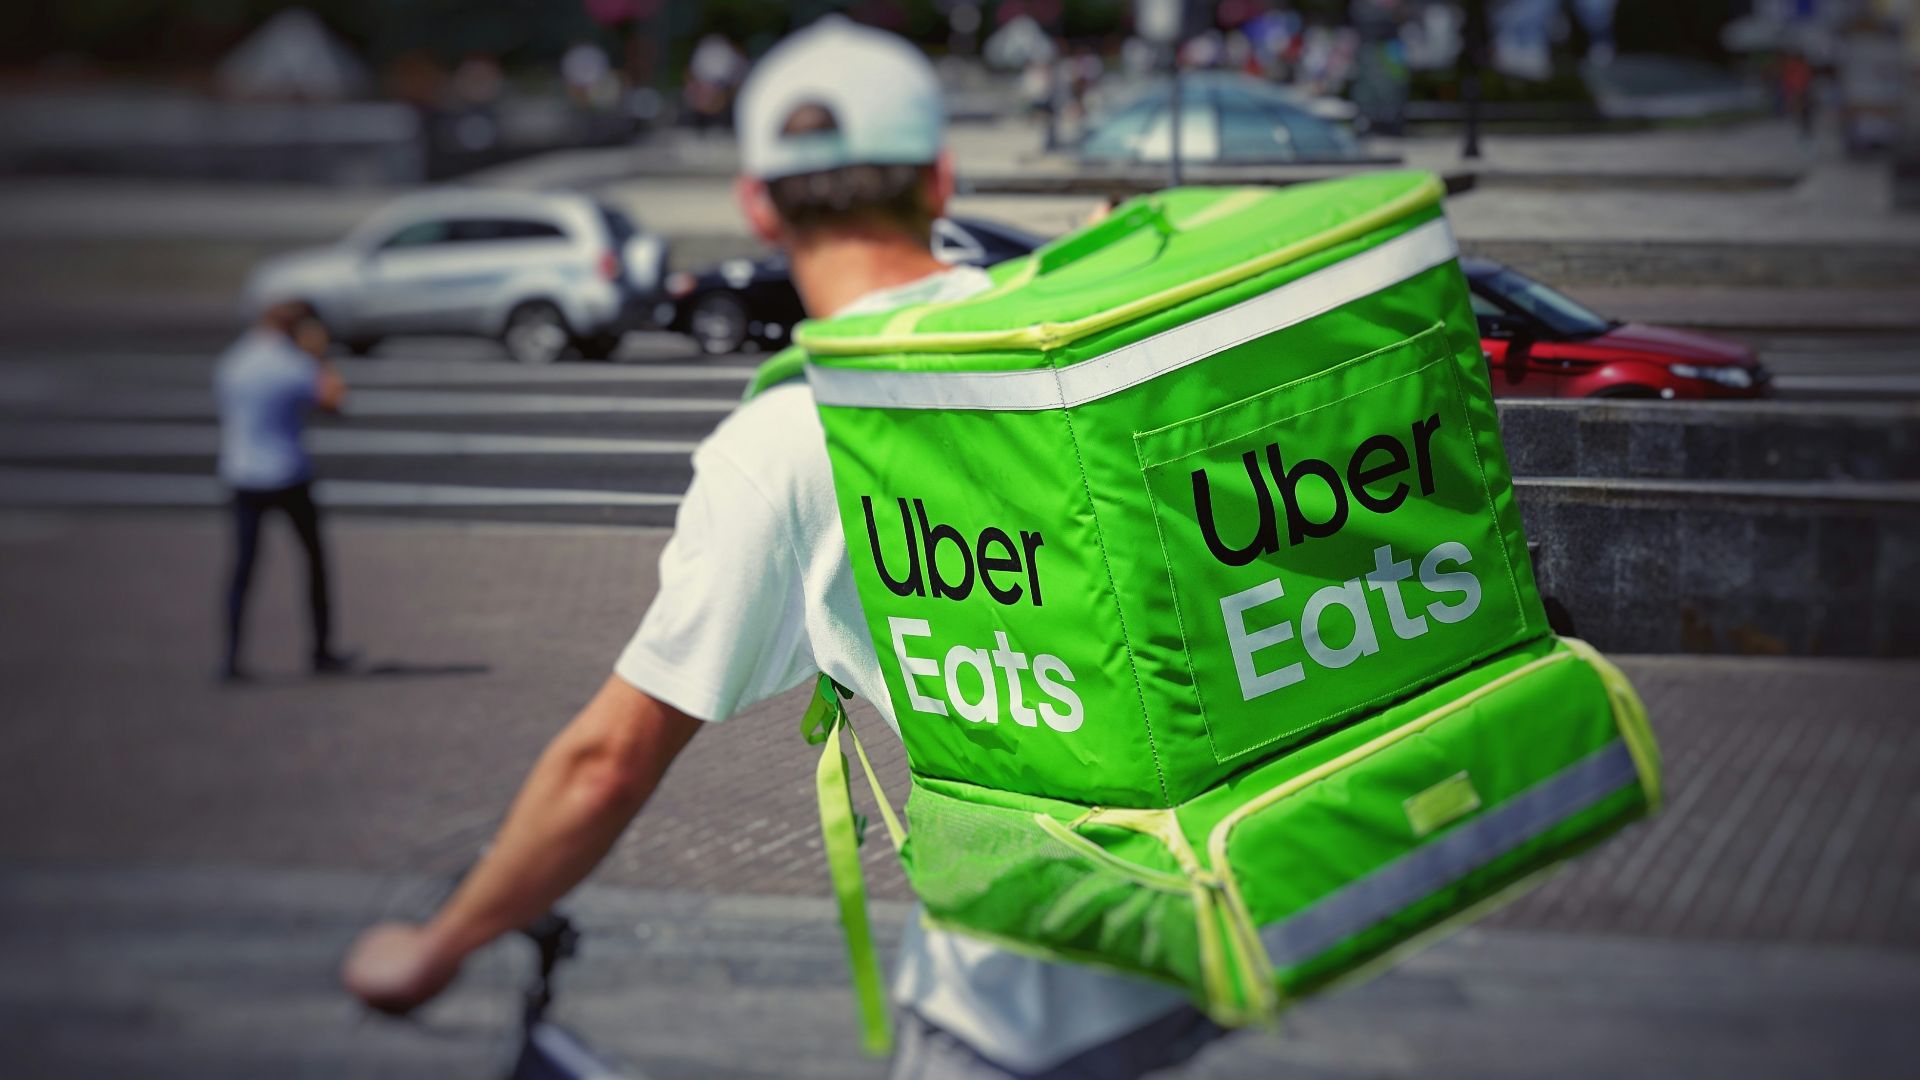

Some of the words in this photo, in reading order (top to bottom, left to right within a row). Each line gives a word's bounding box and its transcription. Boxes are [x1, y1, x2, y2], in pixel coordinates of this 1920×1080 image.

[861, 495, 1044, 606] Uber
[1191, 413, 1441, 567] Uber
[888, 616, 1084, 733] Eats
[1219, 541, 1482, 701] Eats
